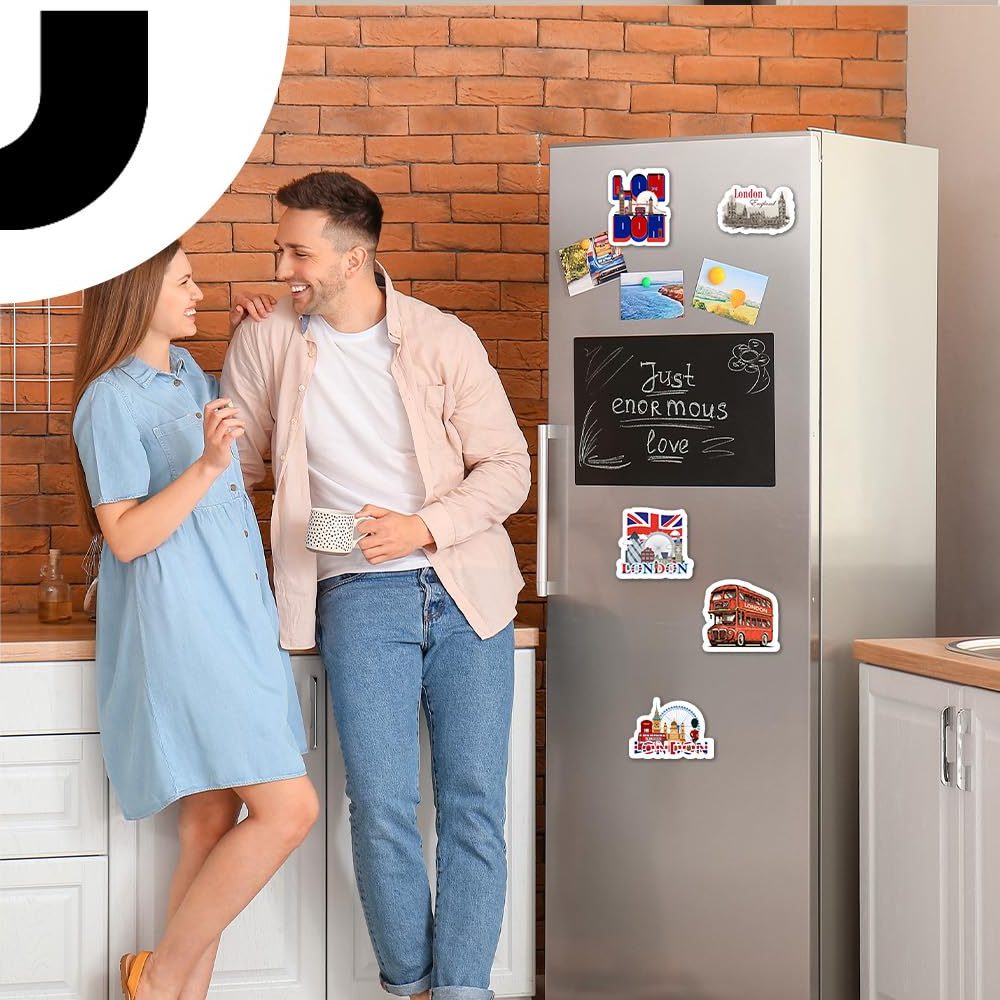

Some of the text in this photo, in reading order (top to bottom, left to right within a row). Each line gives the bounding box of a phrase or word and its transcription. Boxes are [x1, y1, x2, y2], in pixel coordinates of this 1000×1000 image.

[734, 188, 763, 199] London
[640, 361, 696, 393] Just
[646, 429, 689, 454] love
[622, 563, 688, 575] LONDON
[744, 602, 768, 614] LONDON
